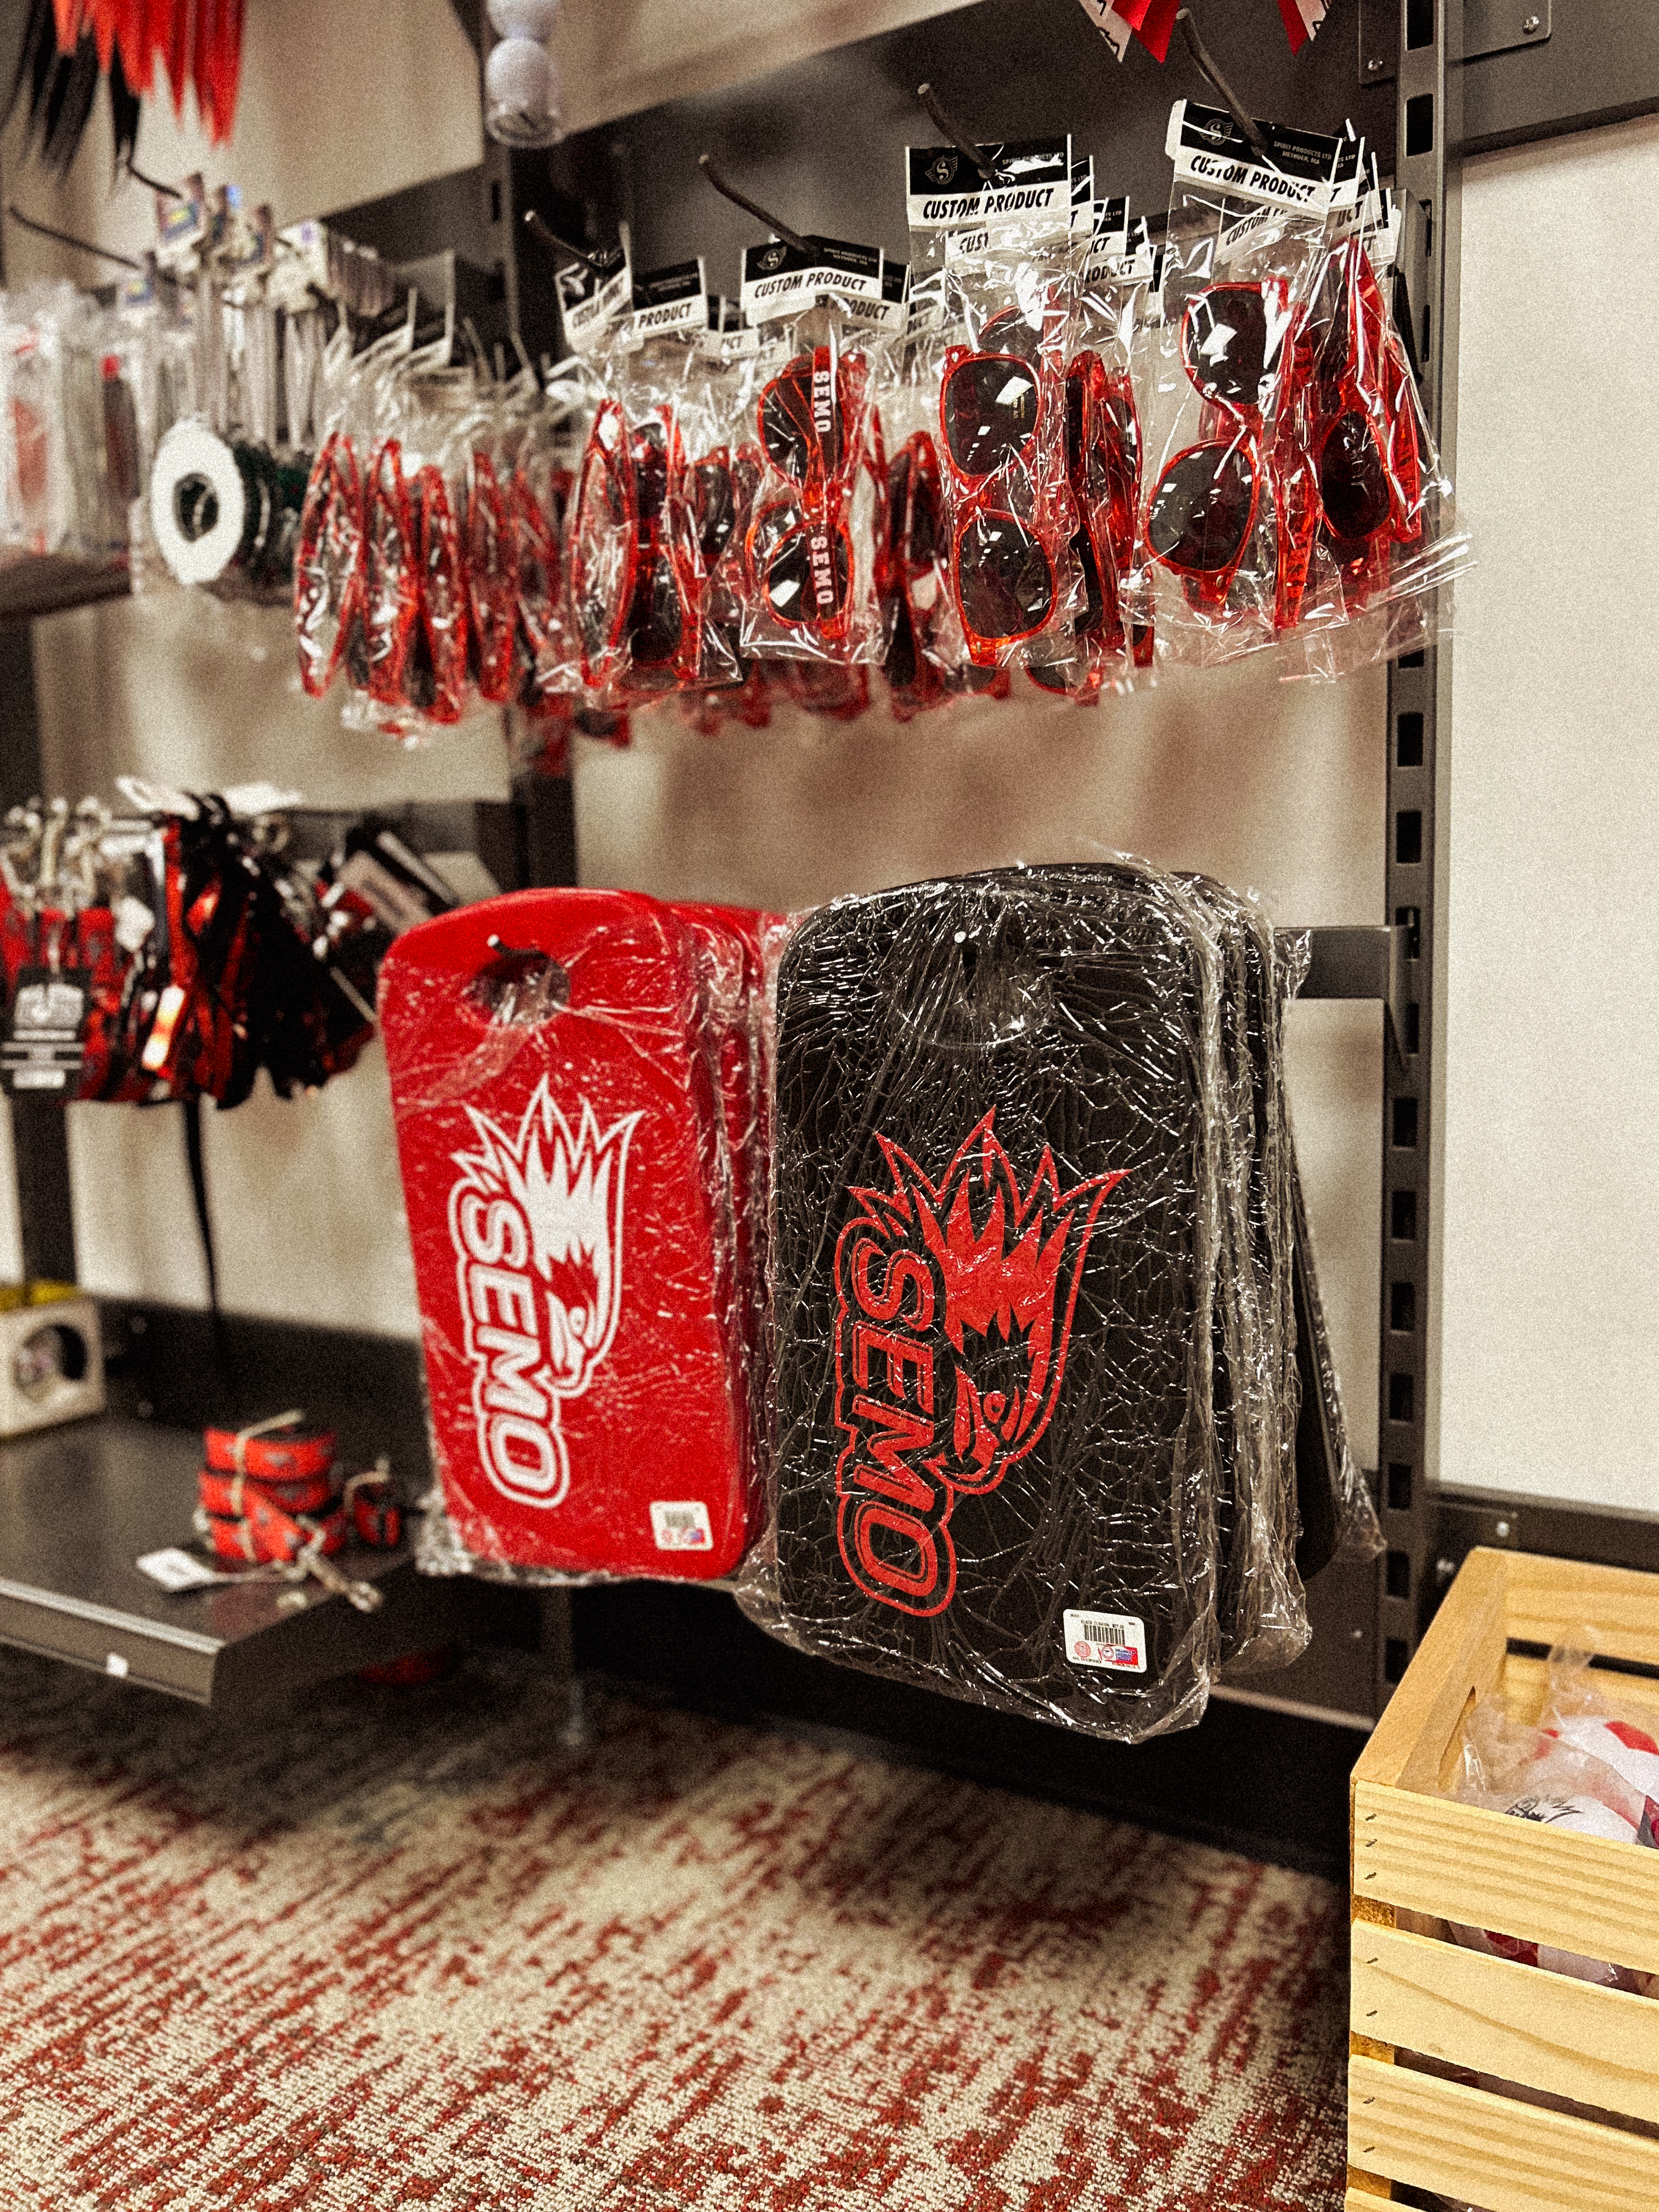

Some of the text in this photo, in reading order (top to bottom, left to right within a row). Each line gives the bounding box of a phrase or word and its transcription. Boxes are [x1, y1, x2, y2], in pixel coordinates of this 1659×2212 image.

[923, 188, 1054, 219] CUSTOM PRODUCT
[1190, 155, 1248, 184] CUSTOM
[1250, 171, 1316, 202] PRODUCT
[754, 275, 803, 298] CUSTOM
[806, 272, 867, 292] PRODUCT
[639, 303, 692, 329] PRODUCT
[812, 370, 831, 433] SEMO
[810, 536, 834, 605] SEMO
[462, 1192, 557, 1492] SEMO
[850, 1237, 939, 1597] SEMO
